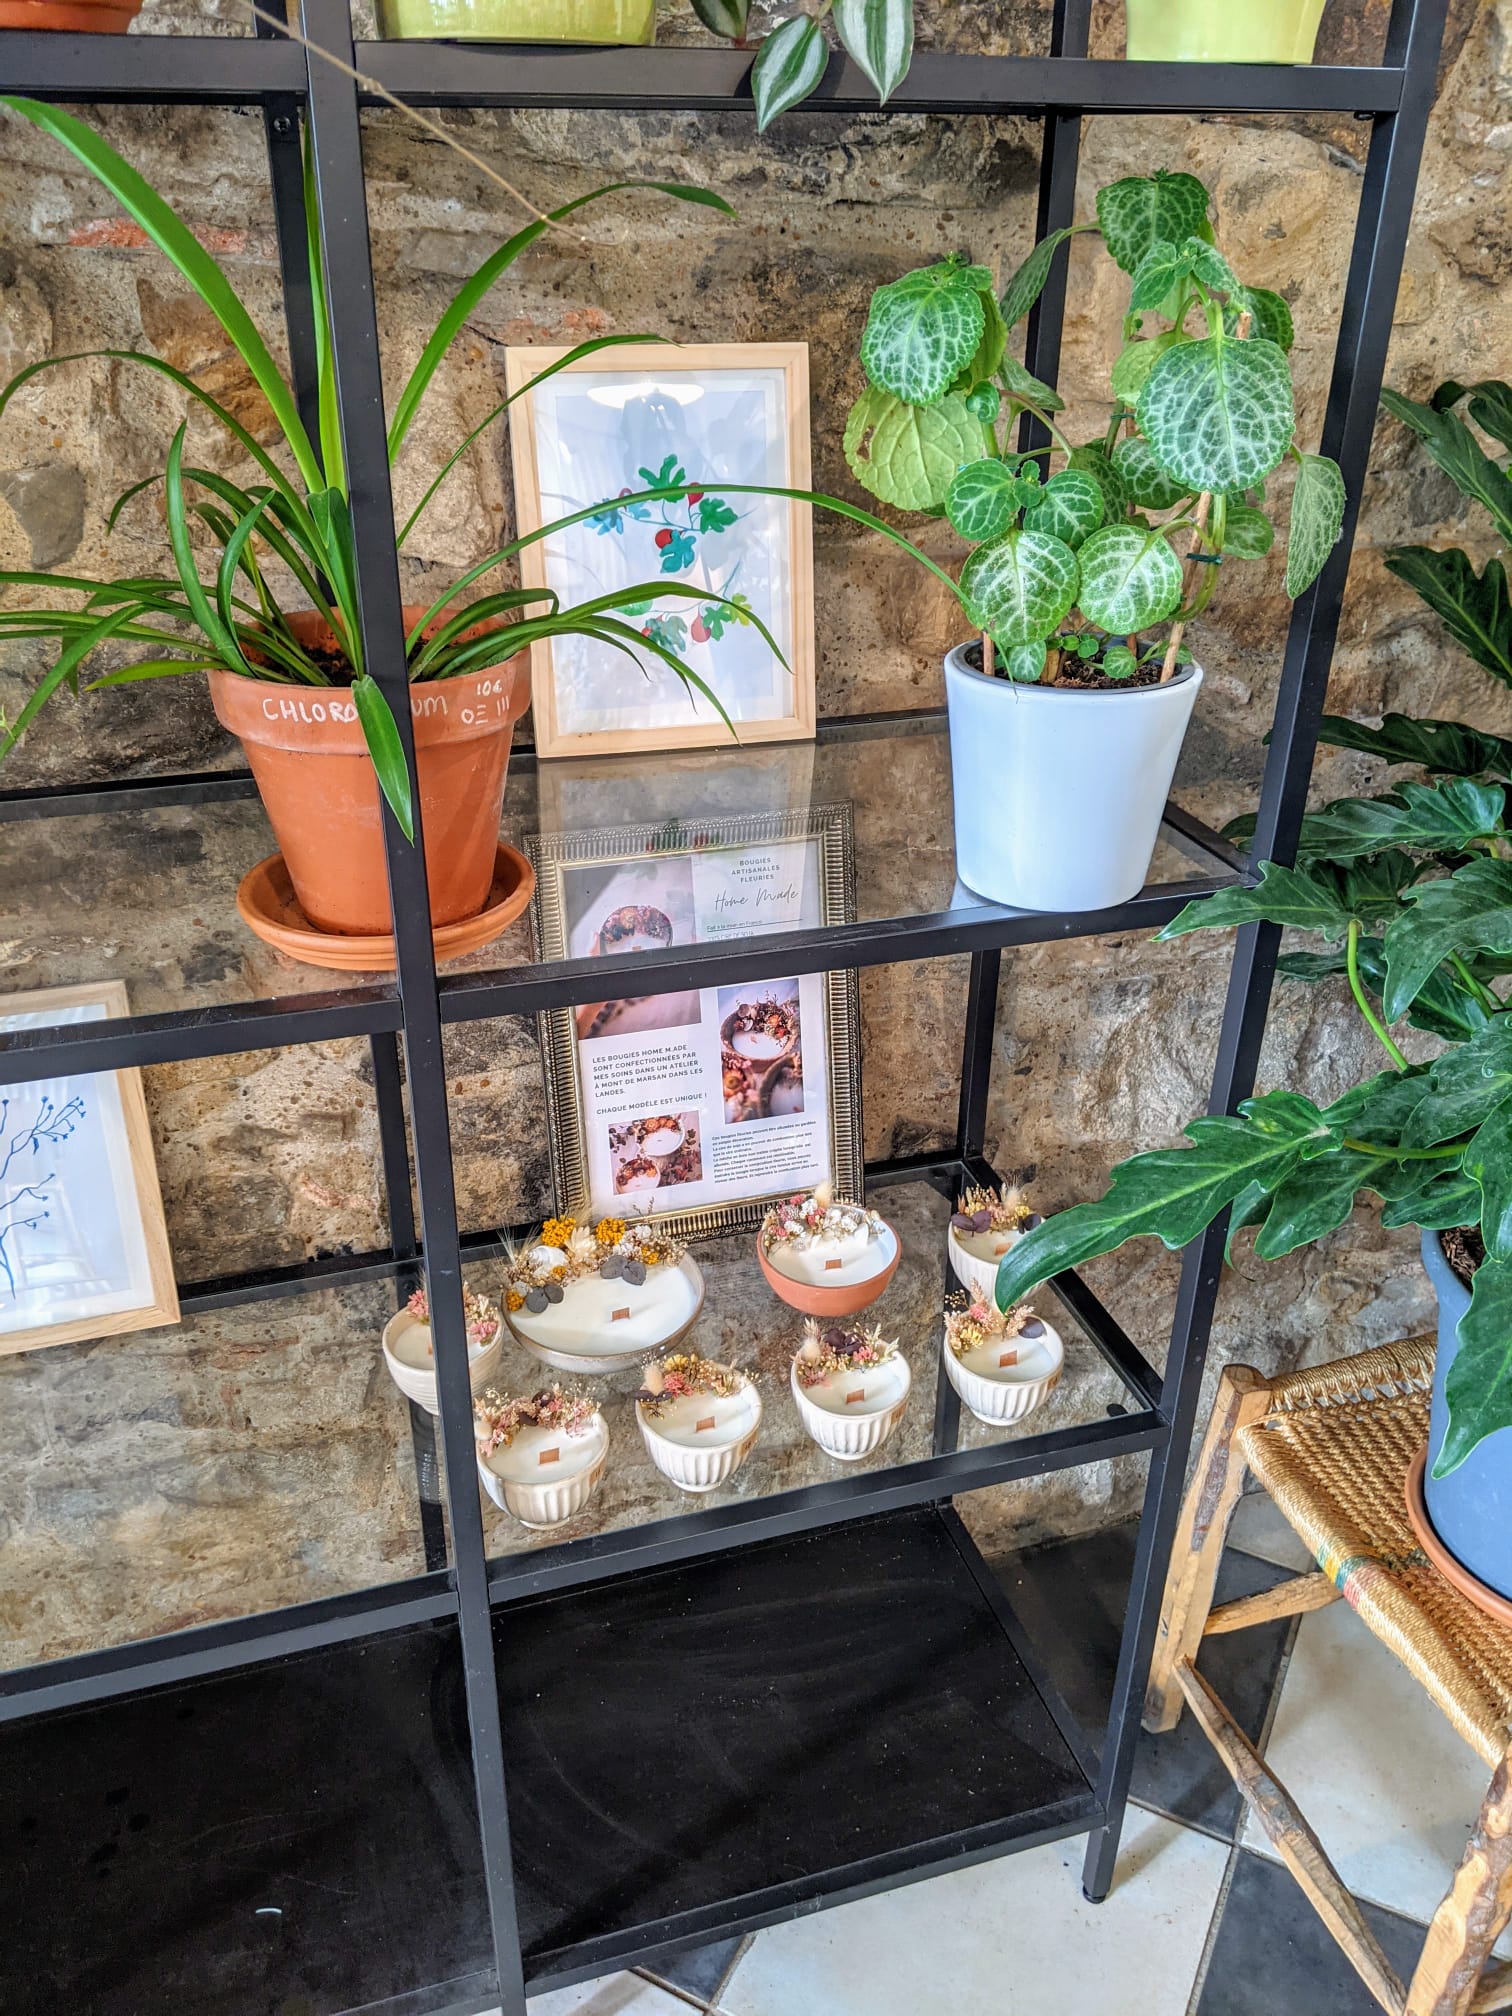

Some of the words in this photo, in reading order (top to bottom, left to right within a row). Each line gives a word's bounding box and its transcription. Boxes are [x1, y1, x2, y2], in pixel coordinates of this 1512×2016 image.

[731, 864, 780, 875] ARTISANALES
[740, 857, 771, 867] BOUGIES
[740, 874, 775, 884] FLEURIES
[714, 889, 749, 912] Home
[755, 883, 799, 907] Made
[592, 1056, 606, 1064] LES
[608, 1051, 640, 1062] BOUGIES
[642, 1047, 663, 1056] HOME
[593, 1064, 613, 1072] SONT
[682, 1051, 696, 1060] PAR
[593, 1071, 609, 1080] MES
[611, 1069, 633, 1078] SOINS
[635, 1066, 655, 1075] DANS
[669, 1060, 699, 1069] ATELIER
[602, 1079, 623, 1089] MONT
[625, 1077, 635, 1085] DE
[636, 1073, 667, 1083] MARSAN
[669, 1070, 688, 1078] DANS
[596, 1104, 627, 1115] CHAQUE
[629, 1098, 658, 1110] MODÈLE
[660, 1097, 673, 1105] EST
[675, 1093, 703, 1103] UNIQUE
